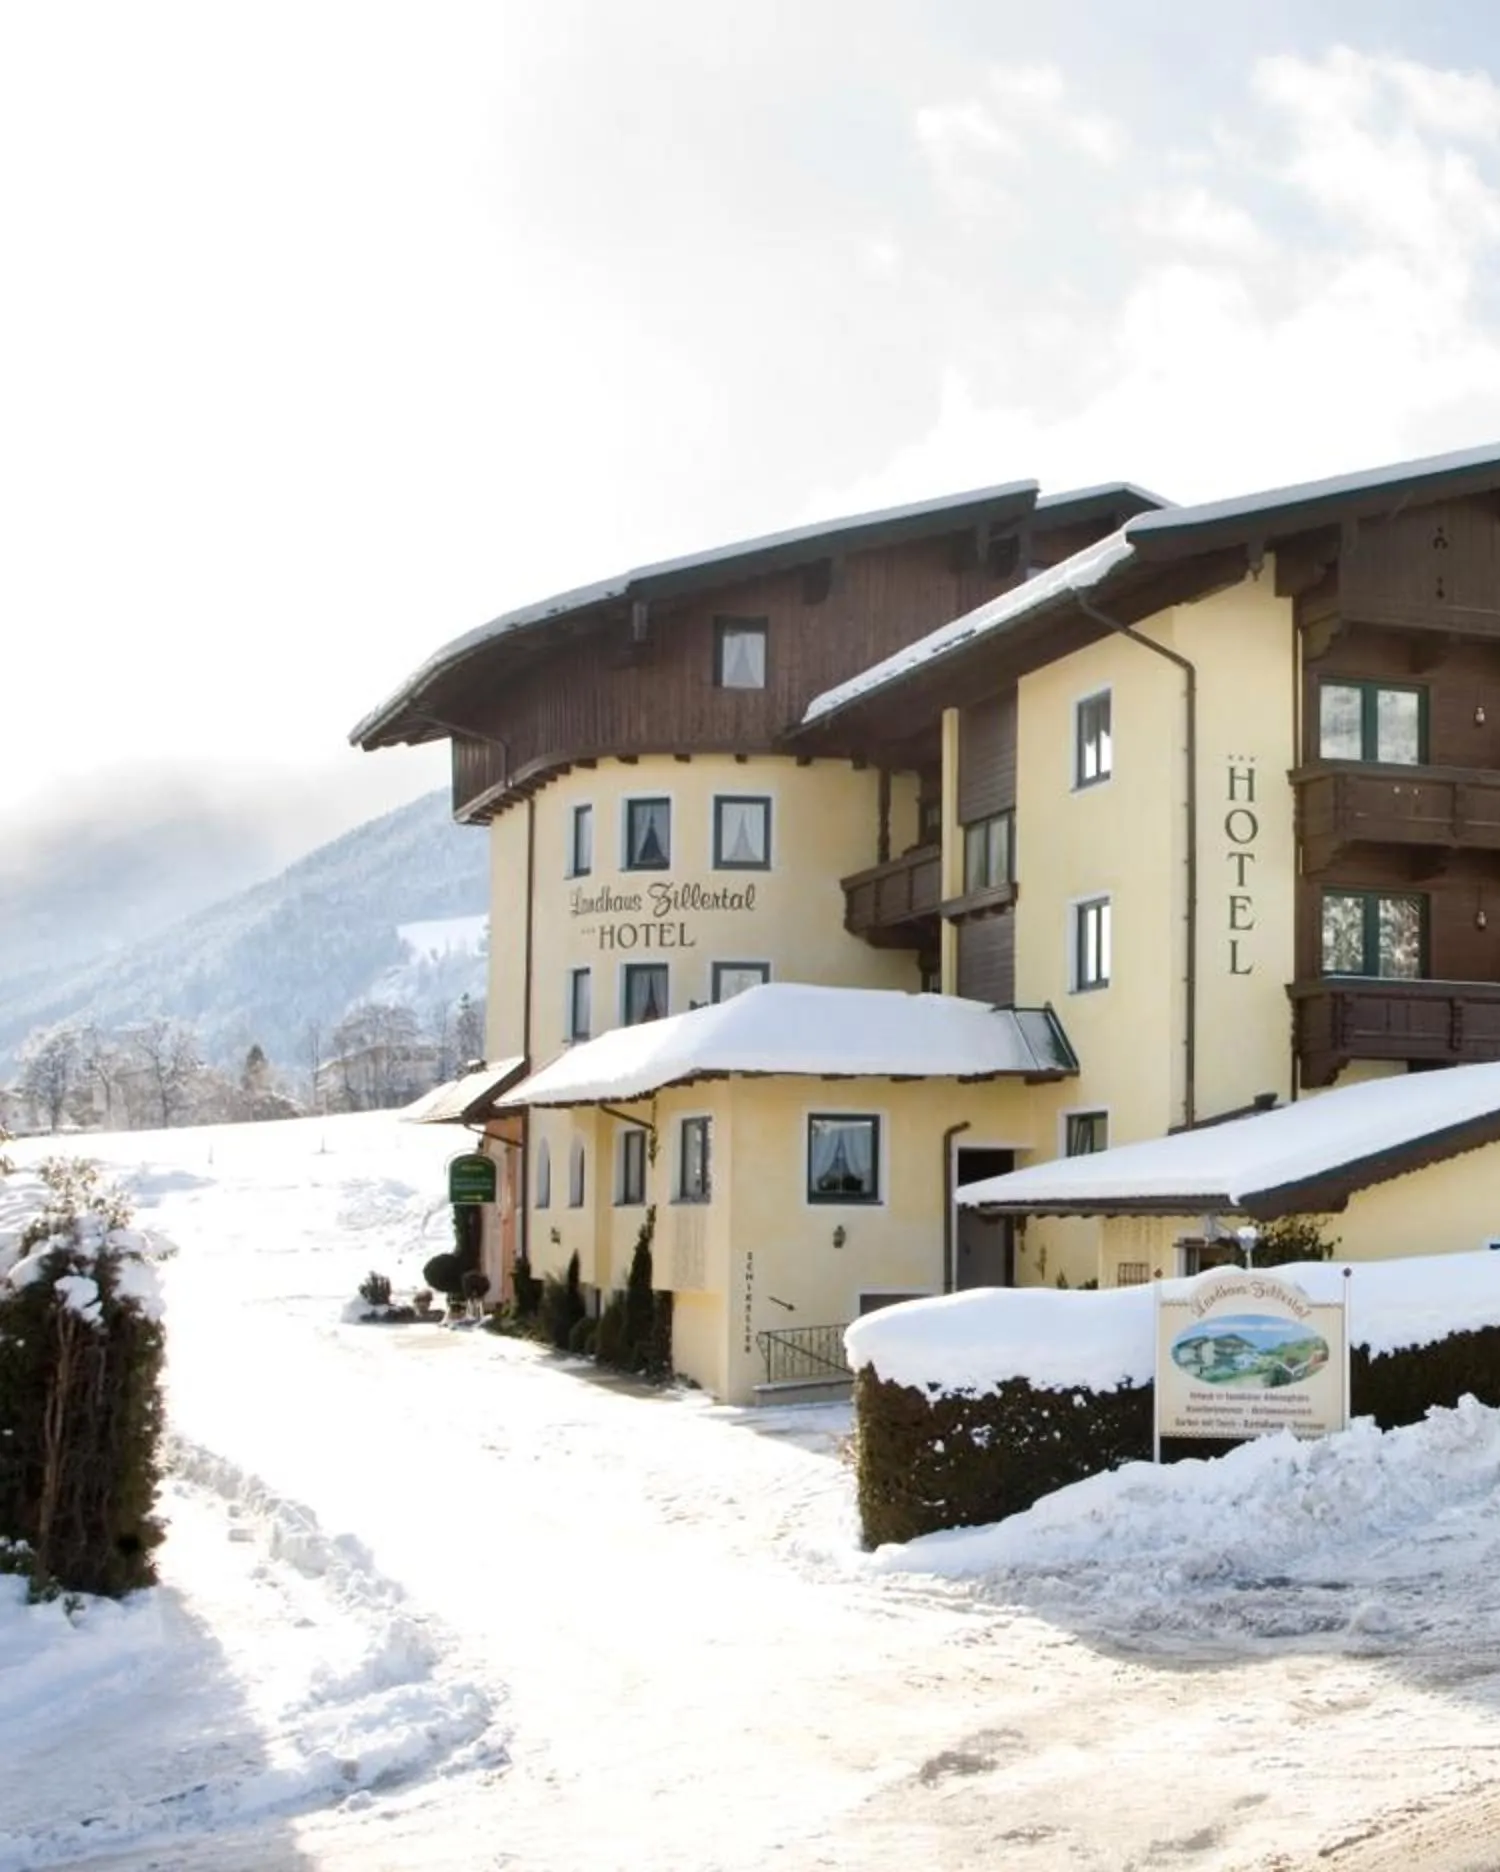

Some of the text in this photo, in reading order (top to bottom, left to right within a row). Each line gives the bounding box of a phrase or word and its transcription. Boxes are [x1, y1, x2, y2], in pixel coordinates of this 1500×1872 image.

[1224, 766, 1259, 976] HOTEL
[570, 882, 757, 918] Landhaus Zillertal
[598, 921, 697, 950] HOTEL
